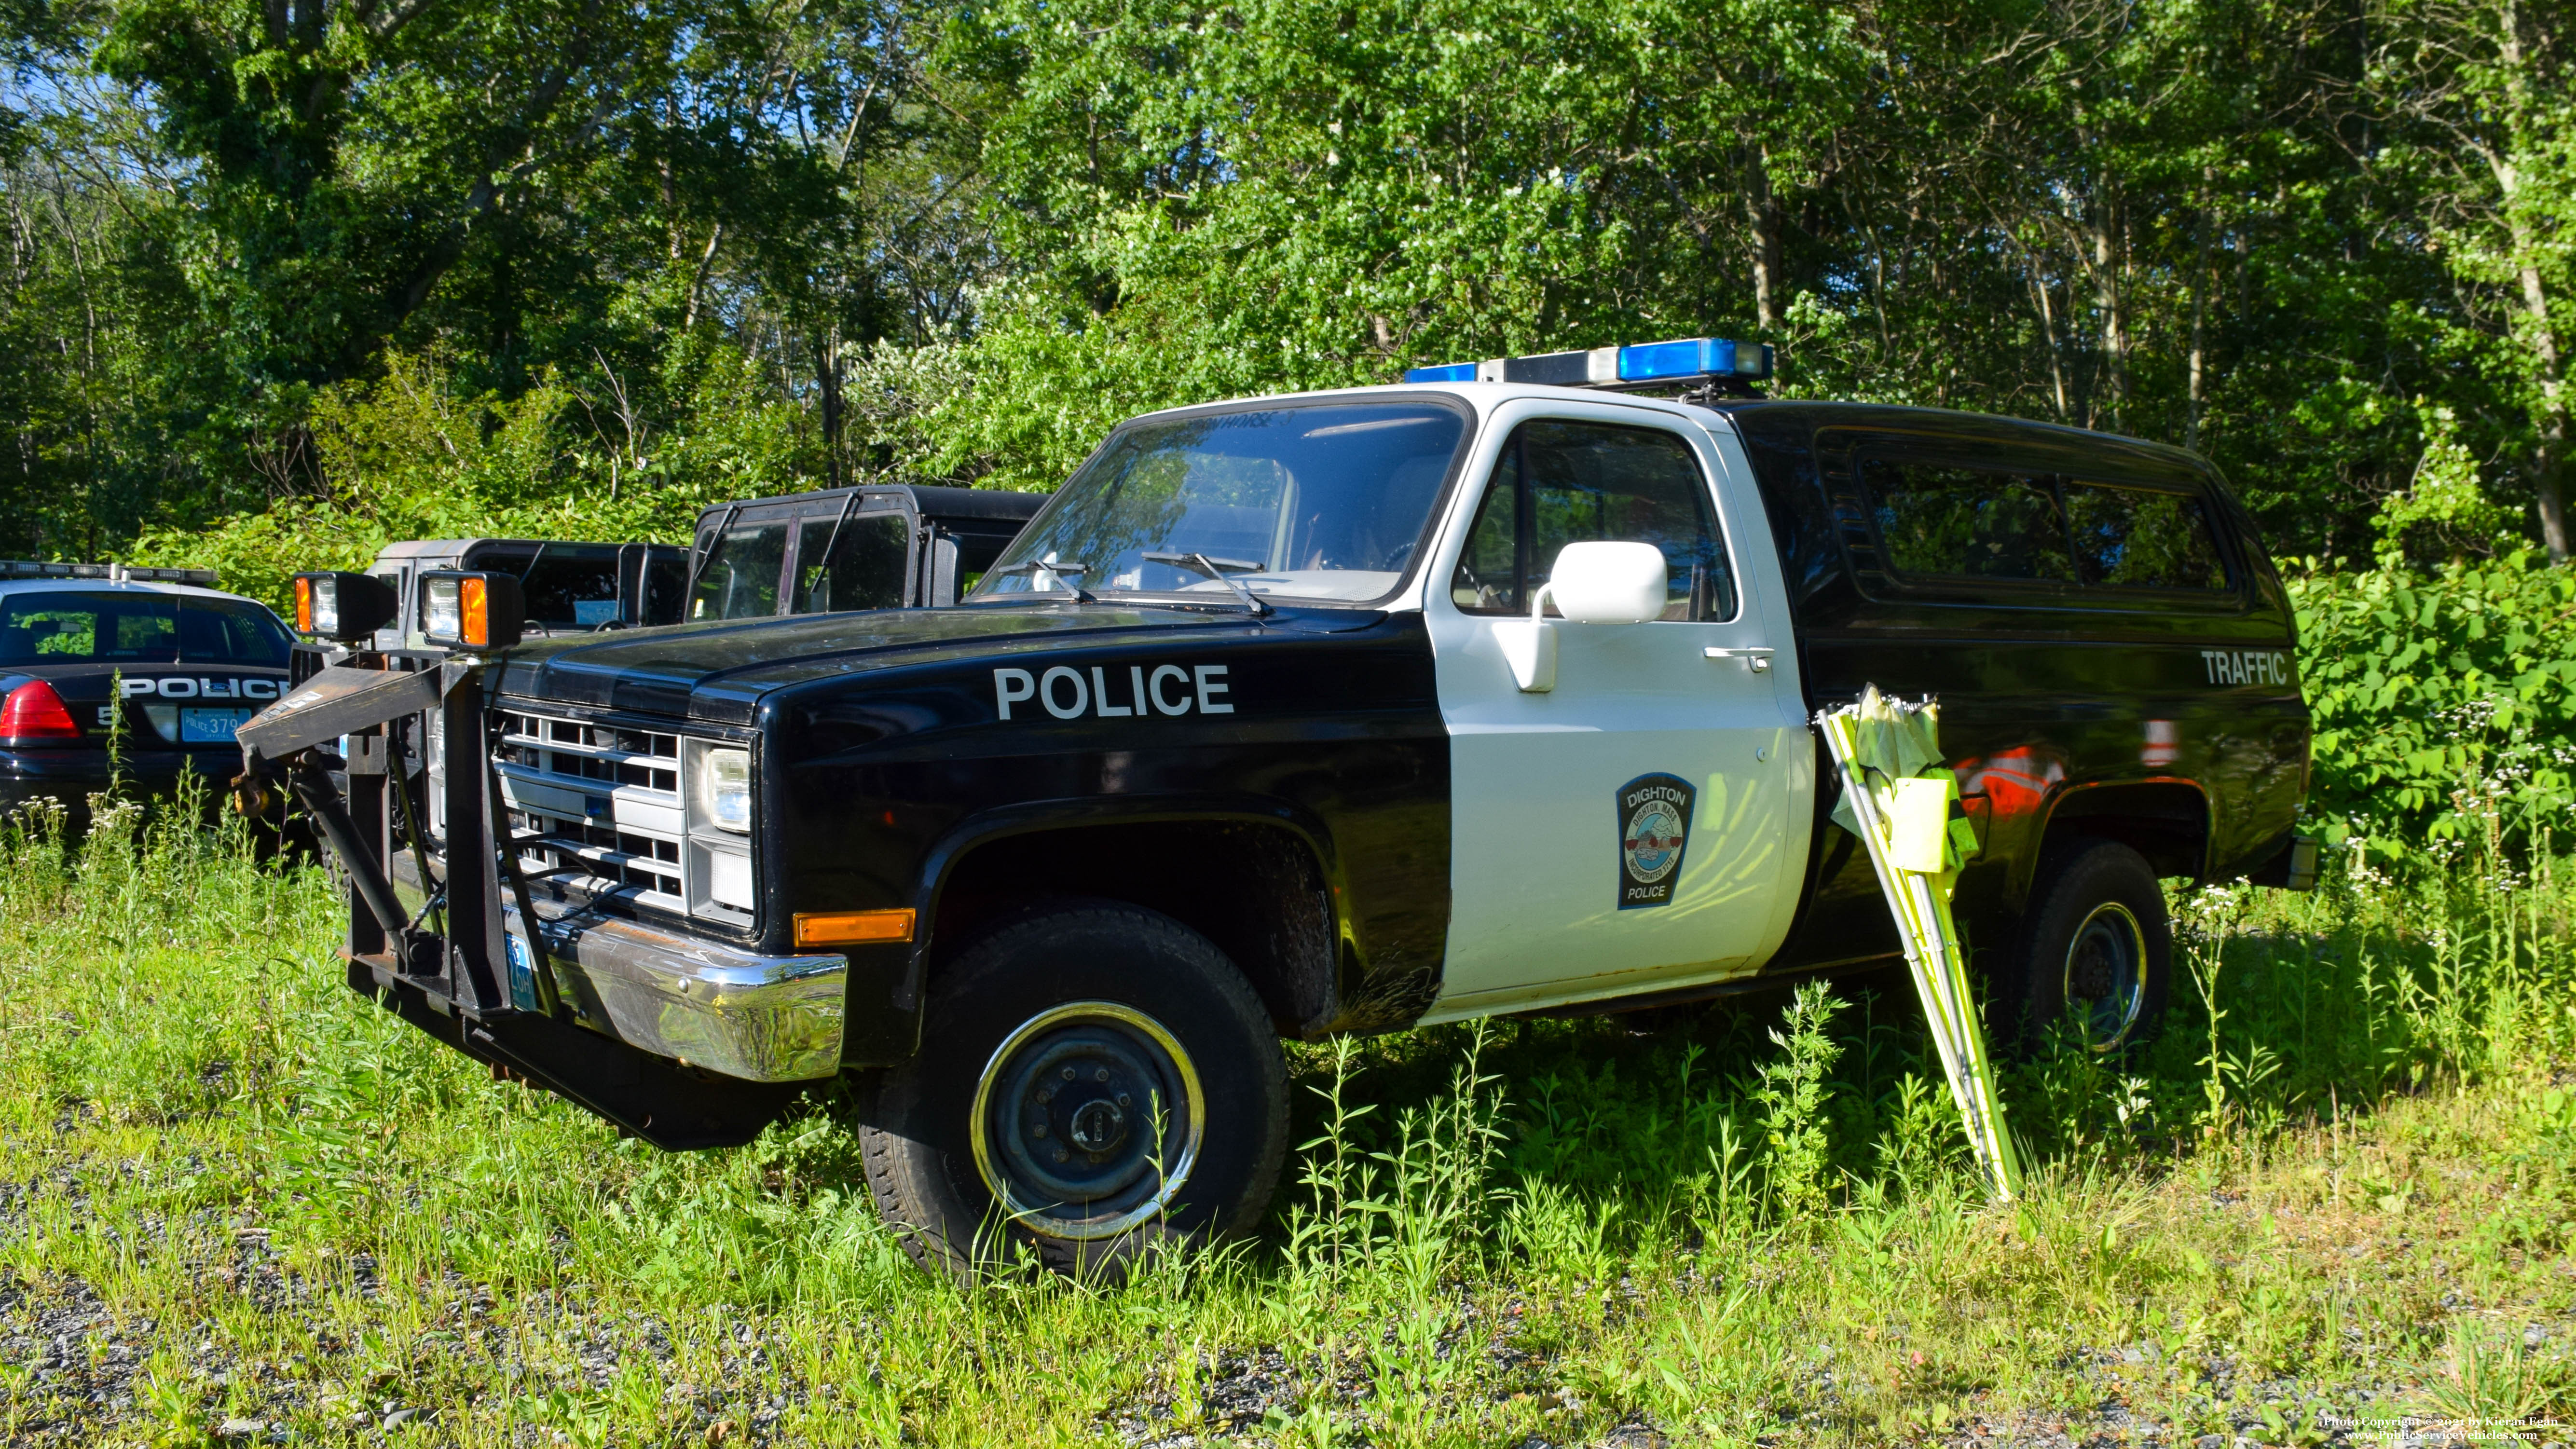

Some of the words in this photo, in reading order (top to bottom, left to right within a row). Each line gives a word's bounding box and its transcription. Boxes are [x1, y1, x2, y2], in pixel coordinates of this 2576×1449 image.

[2201, 651, 2287, 685] TRAFFIC
[994, 664, 1234, 720] POLICE
[186, 716, 208, 733] POLICE
[1627, 786, 1685, 808] DIGHTON
[1633, 802, 1659, 826] DIGHTON,
[1662, 804, 1677, 824] MASS.
[1628, 858, 1662, 880] INCORPORATED
[1664, 857, 1674, 872] 1712
[1628, 886, 1665, 900] POLICE
